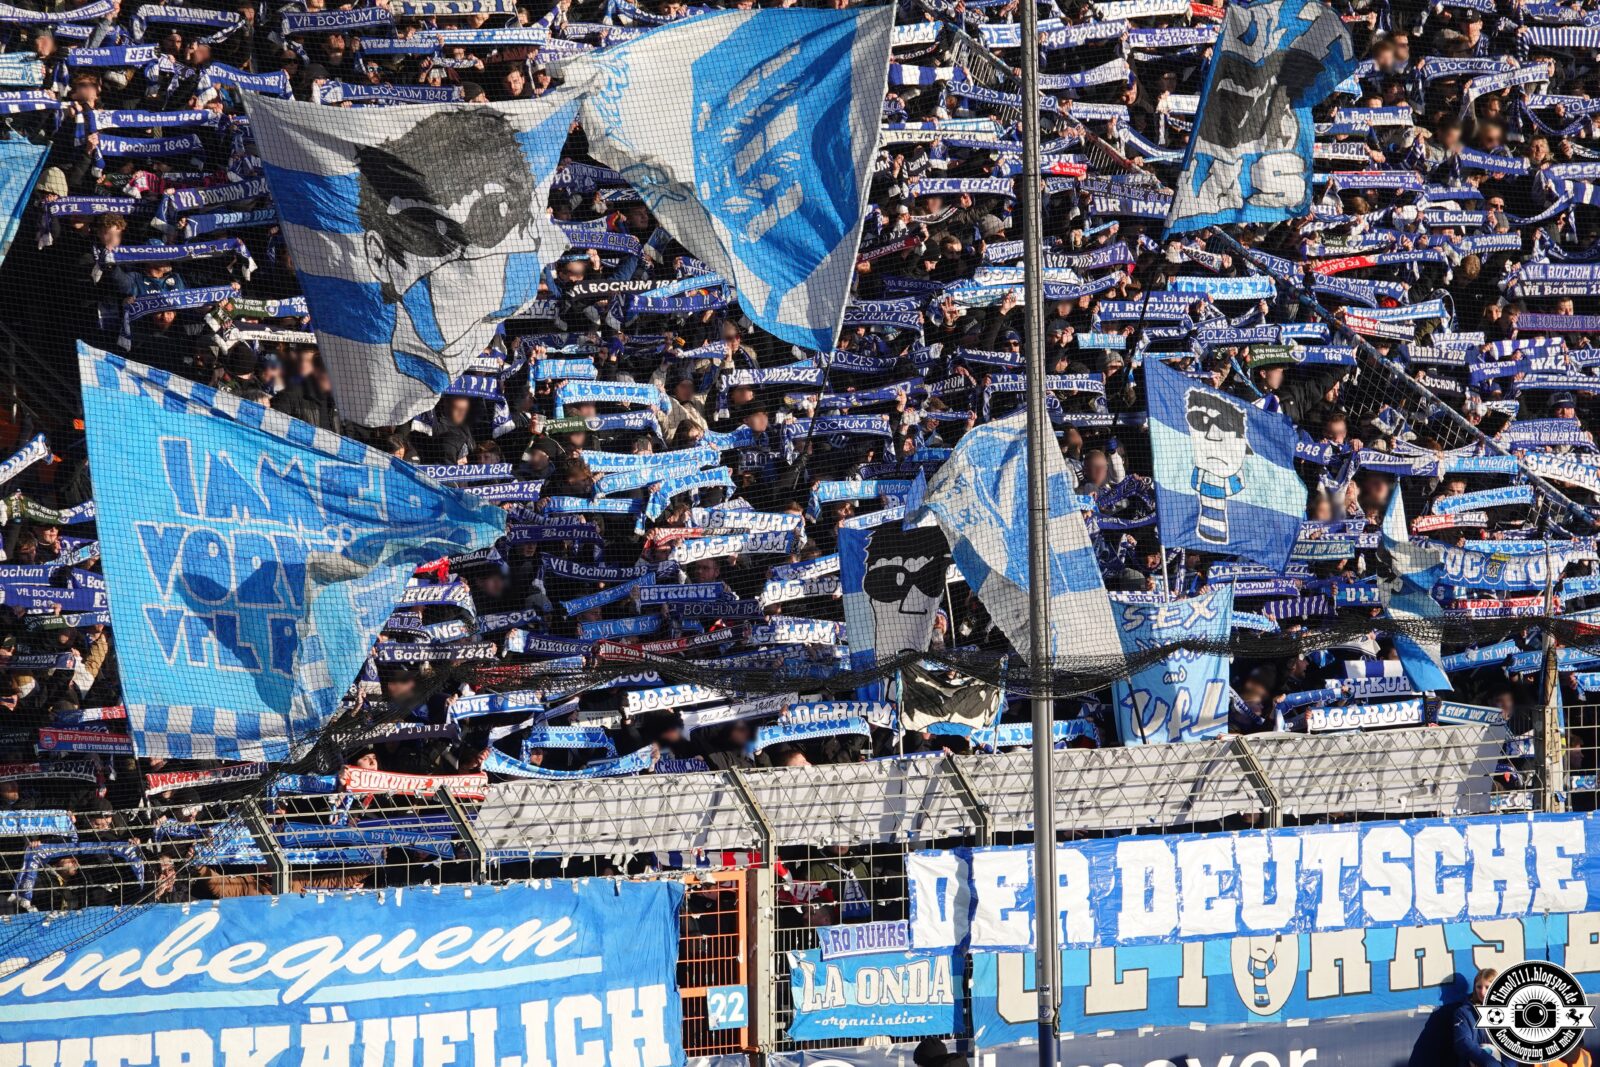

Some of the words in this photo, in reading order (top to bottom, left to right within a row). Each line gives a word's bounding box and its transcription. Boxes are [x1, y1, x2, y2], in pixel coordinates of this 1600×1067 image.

[318, 12, 372, 26] BOCHUM
[1440, 60, 1495, 70] BOCHUM
[349, 85, 368, 95] VfL
[371, 86, 421, 98] BOCHUM
[425, 89, 447, 100] 1848
[946, 80, 999, 99] STOLZES
[119, 114, 135, 122] VfL
[137, 113, 177, 122] Bochum
[179, 112, 202, 121] 1848
[1352, 109, 1396, 122] Bochum
[100, 140, 117, 152] VfL
[120, 141, 160, 153] Bochum
[164, 139, 191, 151] 1848
[180, 192, 198, 207] VfL
[202, 185, 244, 204] BOCHUM
[1444, 212, 1484, 223] Bochum
[130, 246, 179, 254] BOCHUM
[1549, 266, 1591, 279] BOCHUM
[589, 280, 652, 292] BOCHUM
[1522, 286, 1538, 295] VfL
[1539, 285, 1586, 295] Bochum
[1100, 303, 1119, 313] VfL
[1125, 302, 1188, 313] BOCHUM
[1531, 356, 1566, 370] WAZ
[427, 464, 486, 477] BOCHUM
[1463, 458, 1476, 469] ist
[551, 557, 569, 573] VfL
[571, 562, 618, 578] Bochum
[621, 565, 648, 577] 1848
[16, 588, 30, 597] VfL
[32, 589, 74, 600] BOCHUM
[684, 602, 740, 617] BOCHUM
[1121, 596, 1218, 632] SEX
[395, 648, 451, 661] Bochum
[456, 648, 495, 660] 1848
[1163, 666, 1188, 684] and
[1311, 701, 1422, 731] BOCHUM
[1116, 820, 1588, 940] DEUTSCHE
[800, 958, 846, 1014] LA
[856, 956, 955, 1007] ONDA
[709, 991, 745, 1023] 22
